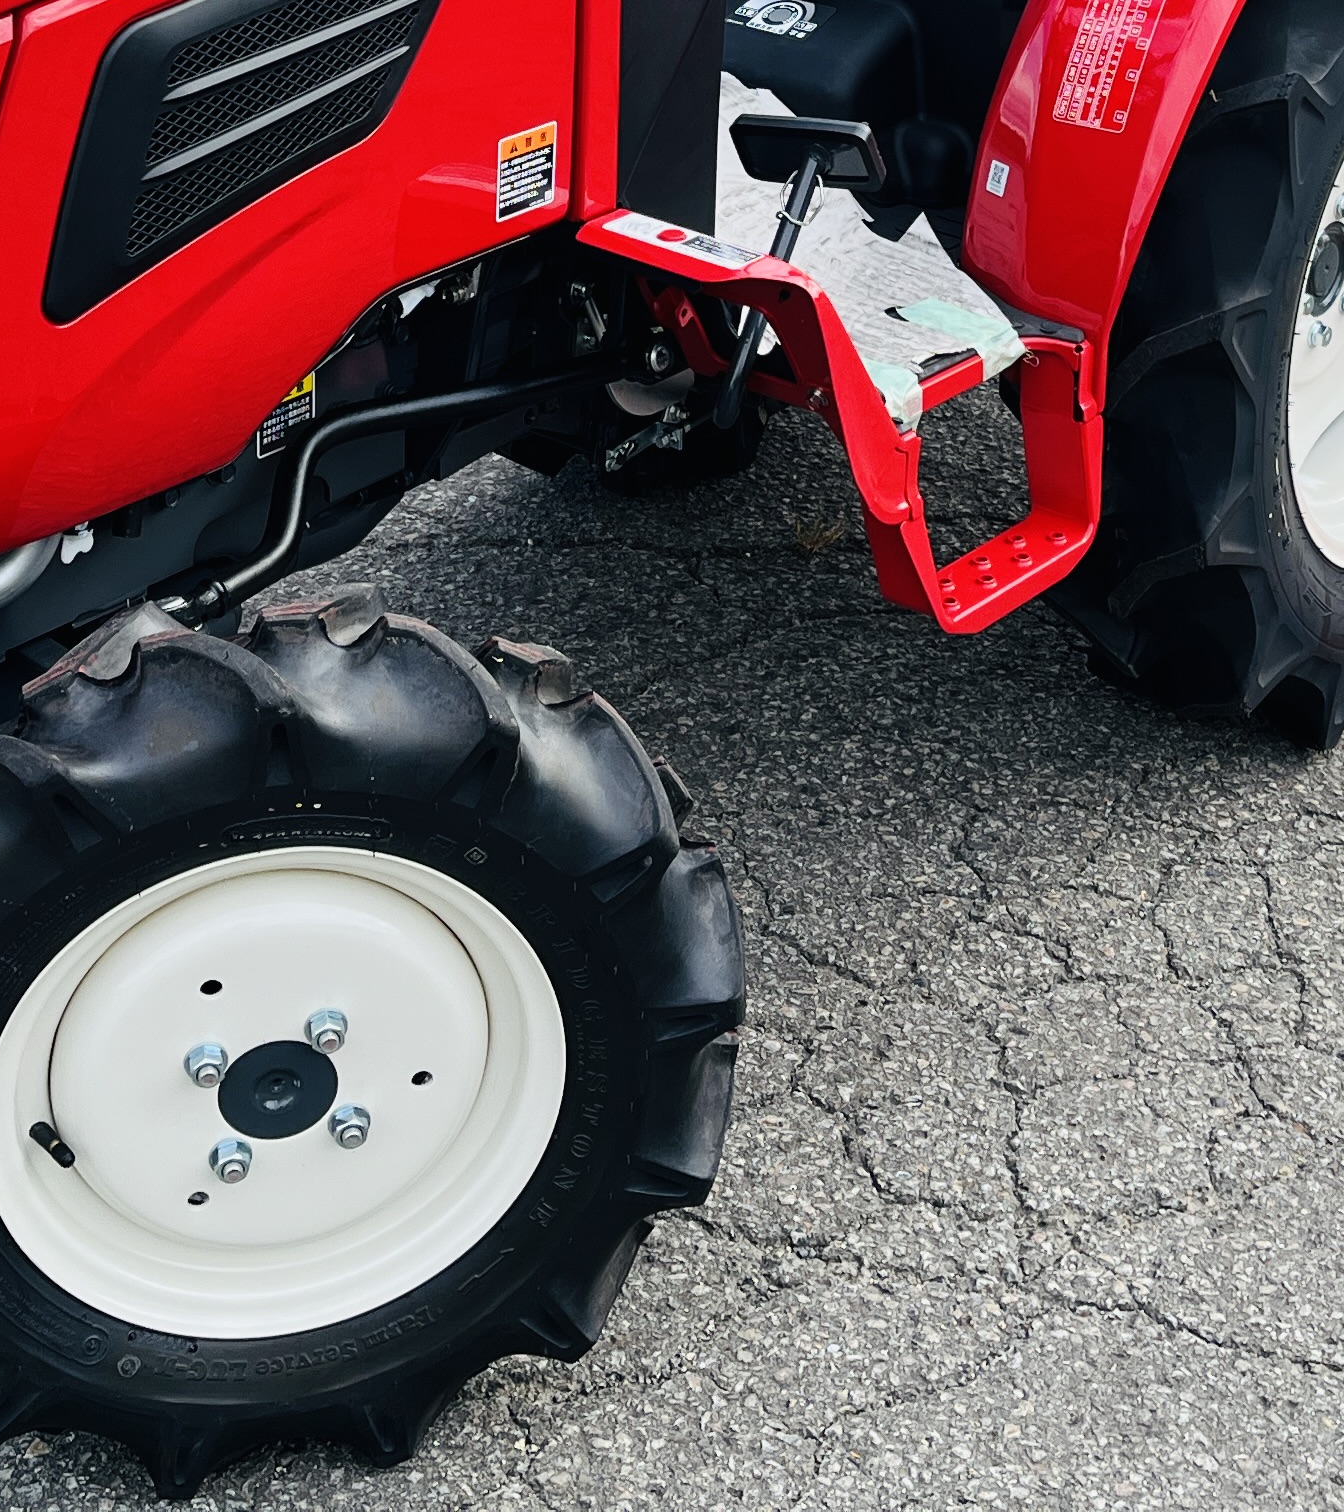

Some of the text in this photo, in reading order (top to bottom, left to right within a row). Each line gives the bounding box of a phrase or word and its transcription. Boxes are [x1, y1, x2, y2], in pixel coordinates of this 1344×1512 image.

[499, 874, 611, 1229] BRIDGESTONE
[362, 1303, 437, 1350] Farm
[254, 1337, 360, 1377] Service
